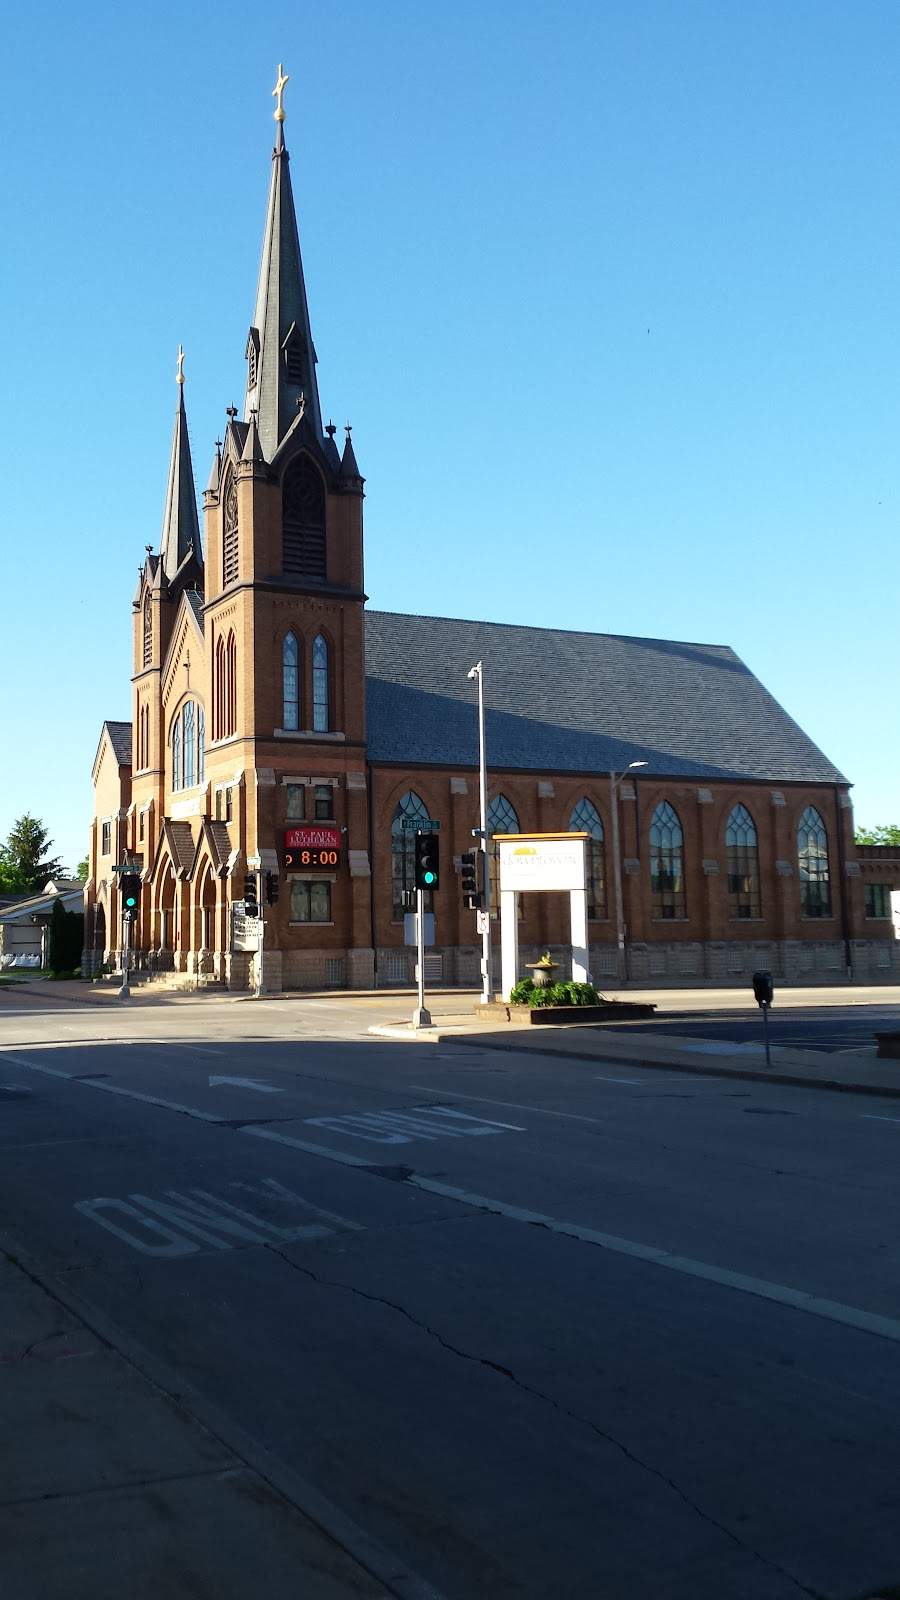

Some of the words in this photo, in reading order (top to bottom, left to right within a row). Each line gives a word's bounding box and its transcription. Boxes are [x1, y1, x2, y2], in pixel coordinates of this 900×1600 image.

[301, 851, 337, 864] 8:00
[302, 1106, 528, 1143] ONLY
[73, 1178, 368, 1257] ONLY
